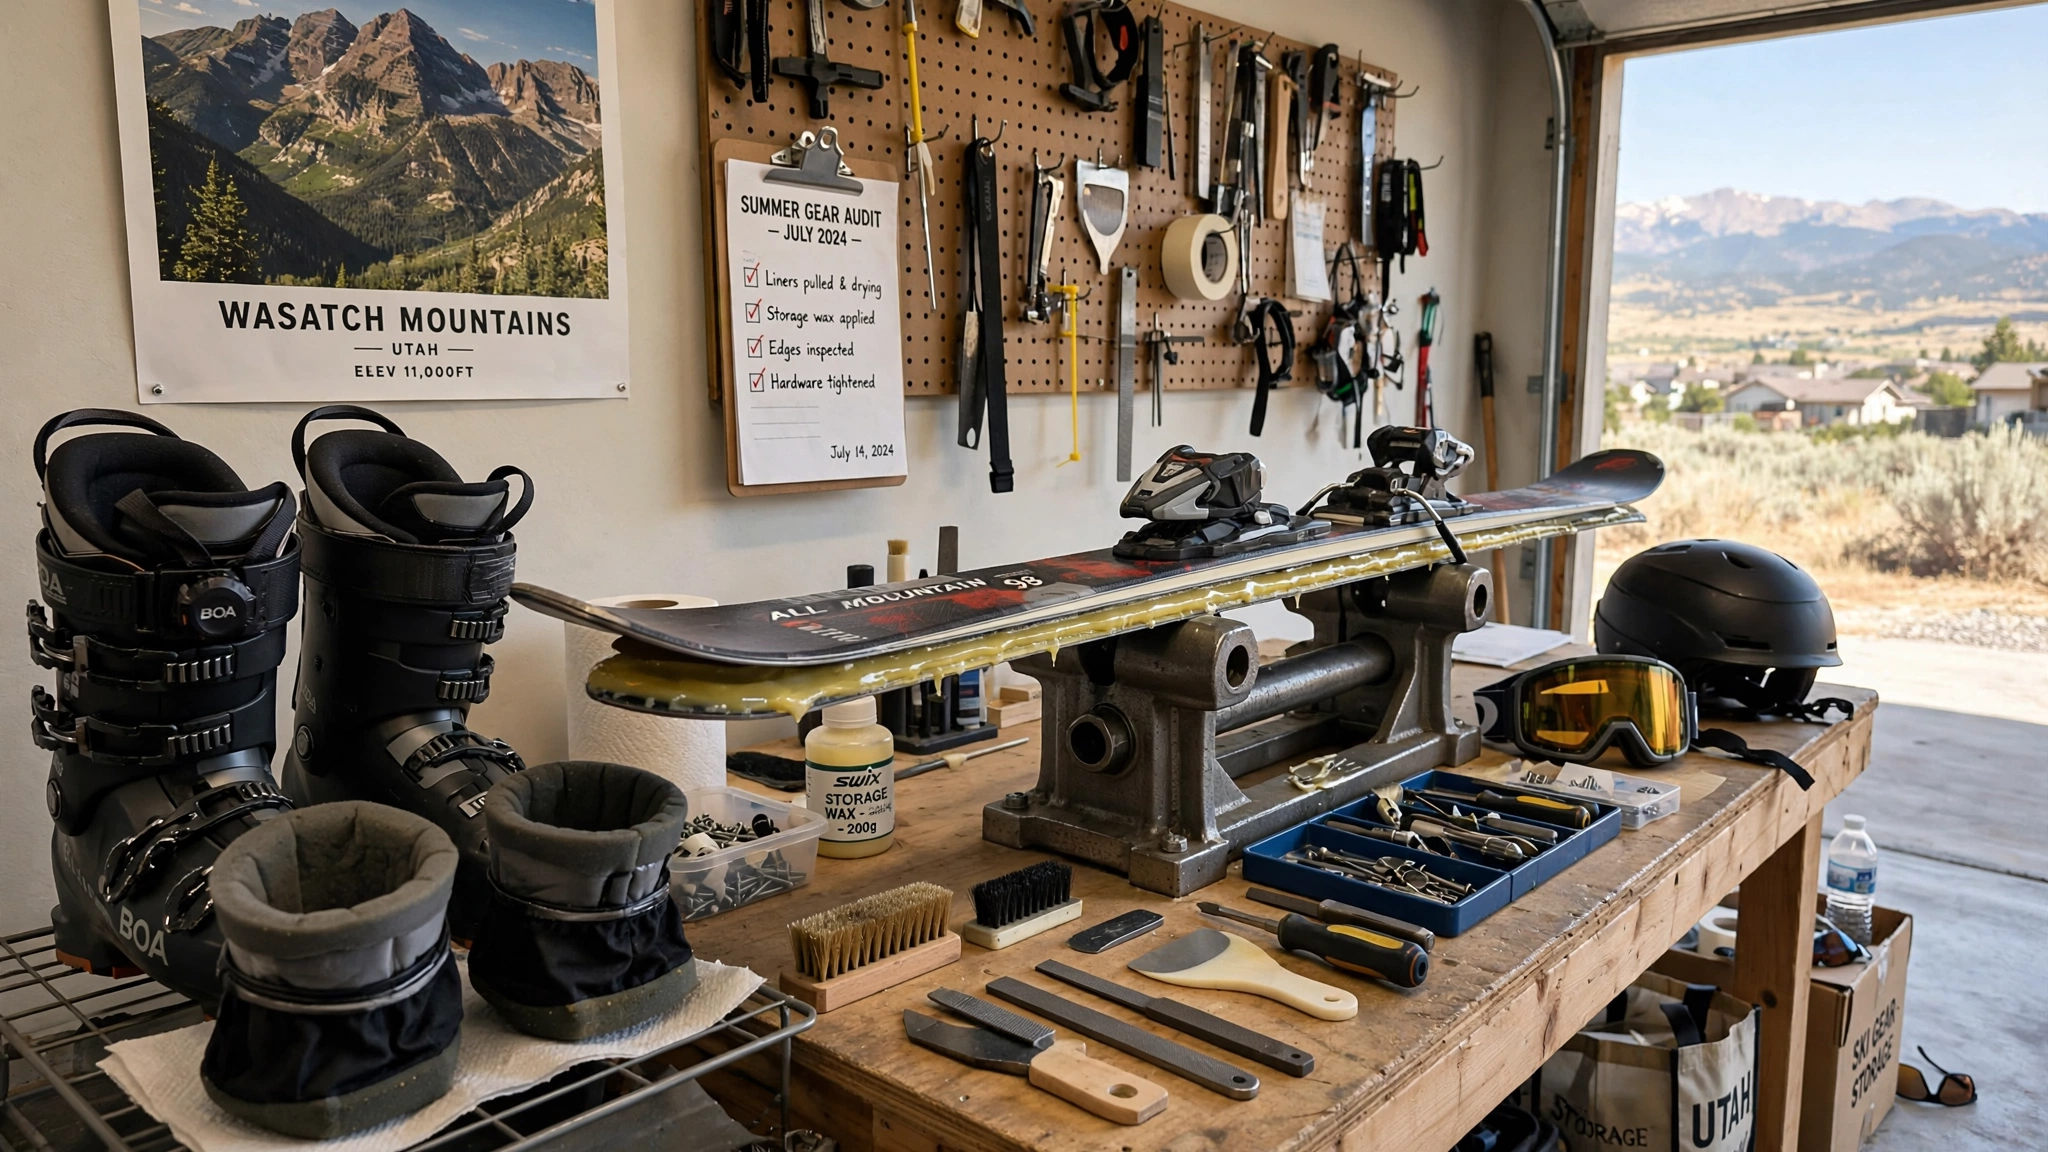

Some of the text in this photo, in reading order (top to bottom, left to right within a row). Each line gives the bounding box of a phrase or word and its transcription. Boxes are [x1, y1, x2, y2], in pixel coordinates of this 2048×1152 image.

[741, 195, 882, 228] SUMMER GEAR AUDIT
[783, 224, 848, 246] JULY 2024
[765, 269, 882, 300] Liners pulled & drying
[219, 300, 571, 336] WASATCH MOUNTAINS
[767, 306, 875, 329] Storage wax applied
[392, 343, 439, 356] UTAH
[769, 339, 854, 362] Edges inspected
[403, 366, 474, 379] 11,000FT
[771, 373, 876, 395] Hardware tightened
[830, 444, 894, 462] July 14, 2024
[37, 561, 64, 596] OA
[770, 575, 1043, 621] ALL MOUNTAIN 98
[200, 605, 237, 620] BOA
[825, 786, 888, 806] STORAGE
[825, 807, 856, 820] WAX
[120, 905, 169, 967] BOA
[1852, 1027, 1870, 1071] SKI
[1851, 1033, 1894, 1109] STORAGE
[1692, 1070, 1751, 1149] UTAH
